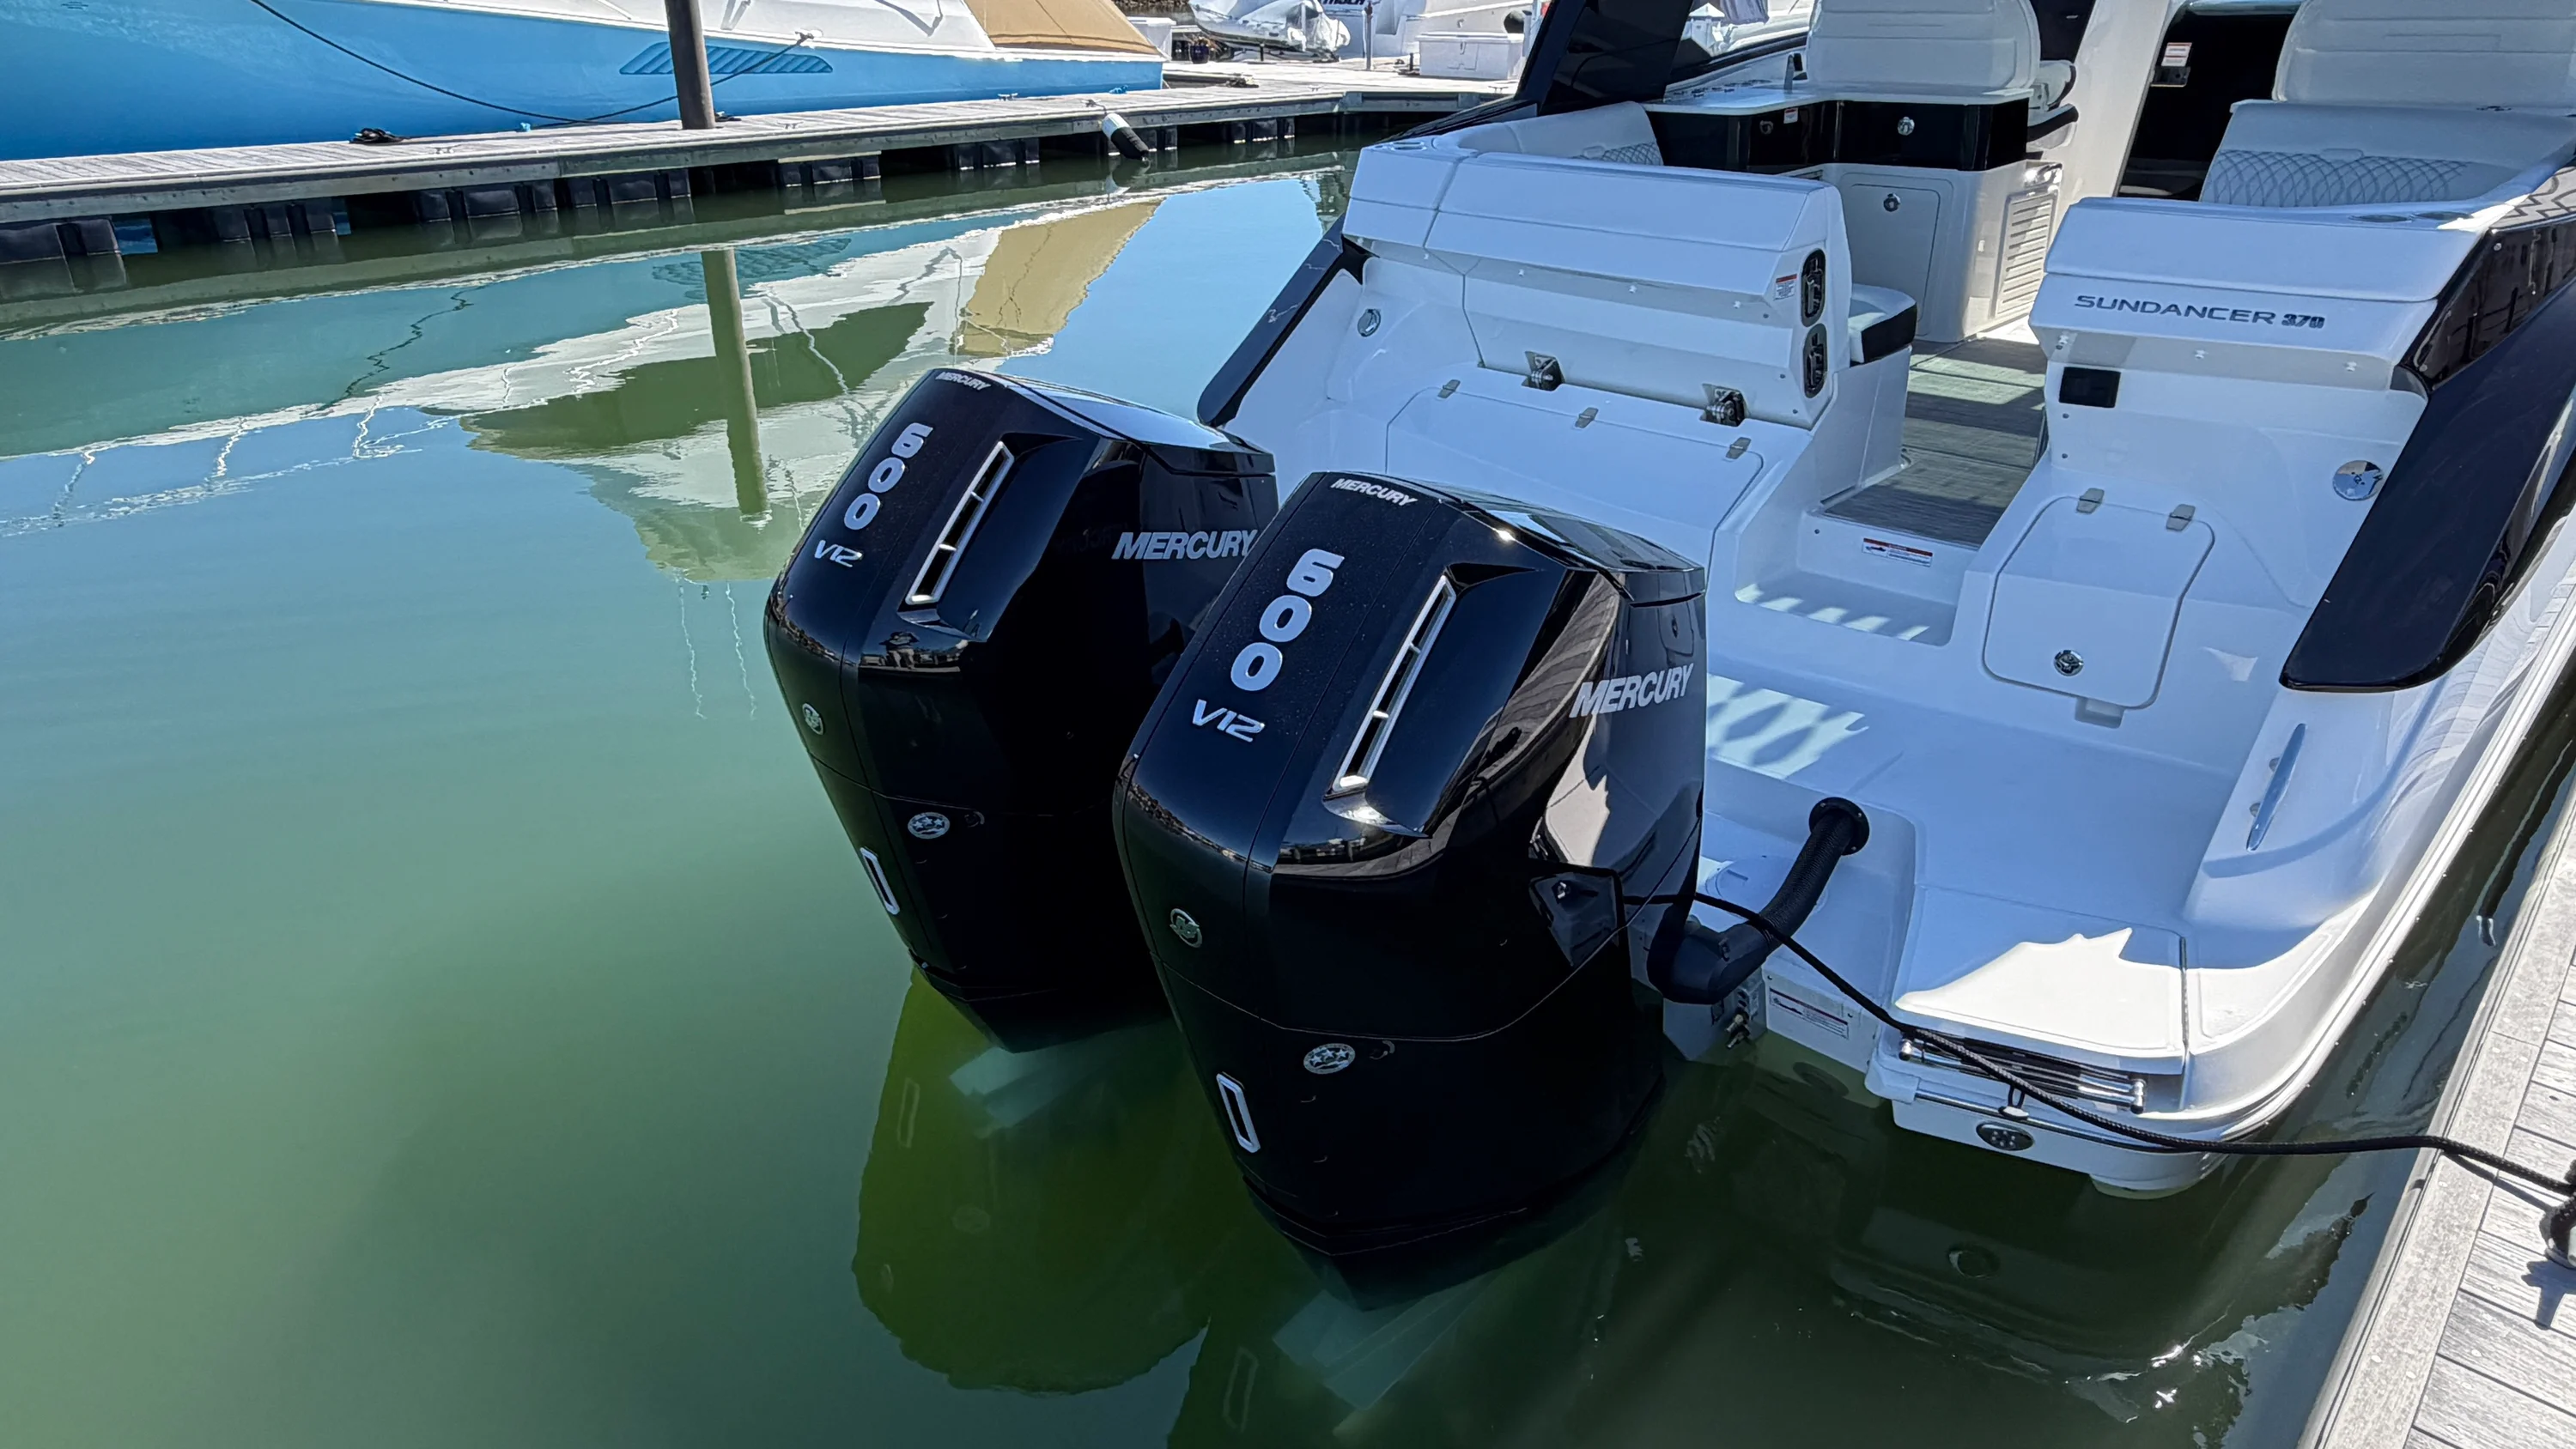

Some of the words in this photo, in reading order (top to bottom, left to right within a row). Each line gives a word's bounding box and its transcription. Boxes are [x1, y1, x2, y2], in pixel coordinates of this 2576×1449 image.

[2075, 295, 2276, 324] SUNDANCER
[2281, 313, 2325, 329] 370
[935, 372, 992, 391] MERCURY
[844, 422, 933, 530] 600
[1330, 478, 1419, 506] MERCURY
[815, 539, 863, 567] V12
[1111, 529, 1258, 560] MERCURY
[1230, 548, 1345, 692] 600
[1569, 663, 1694, 718] MERCURY
[1192, 699, 1265, 743] V12
